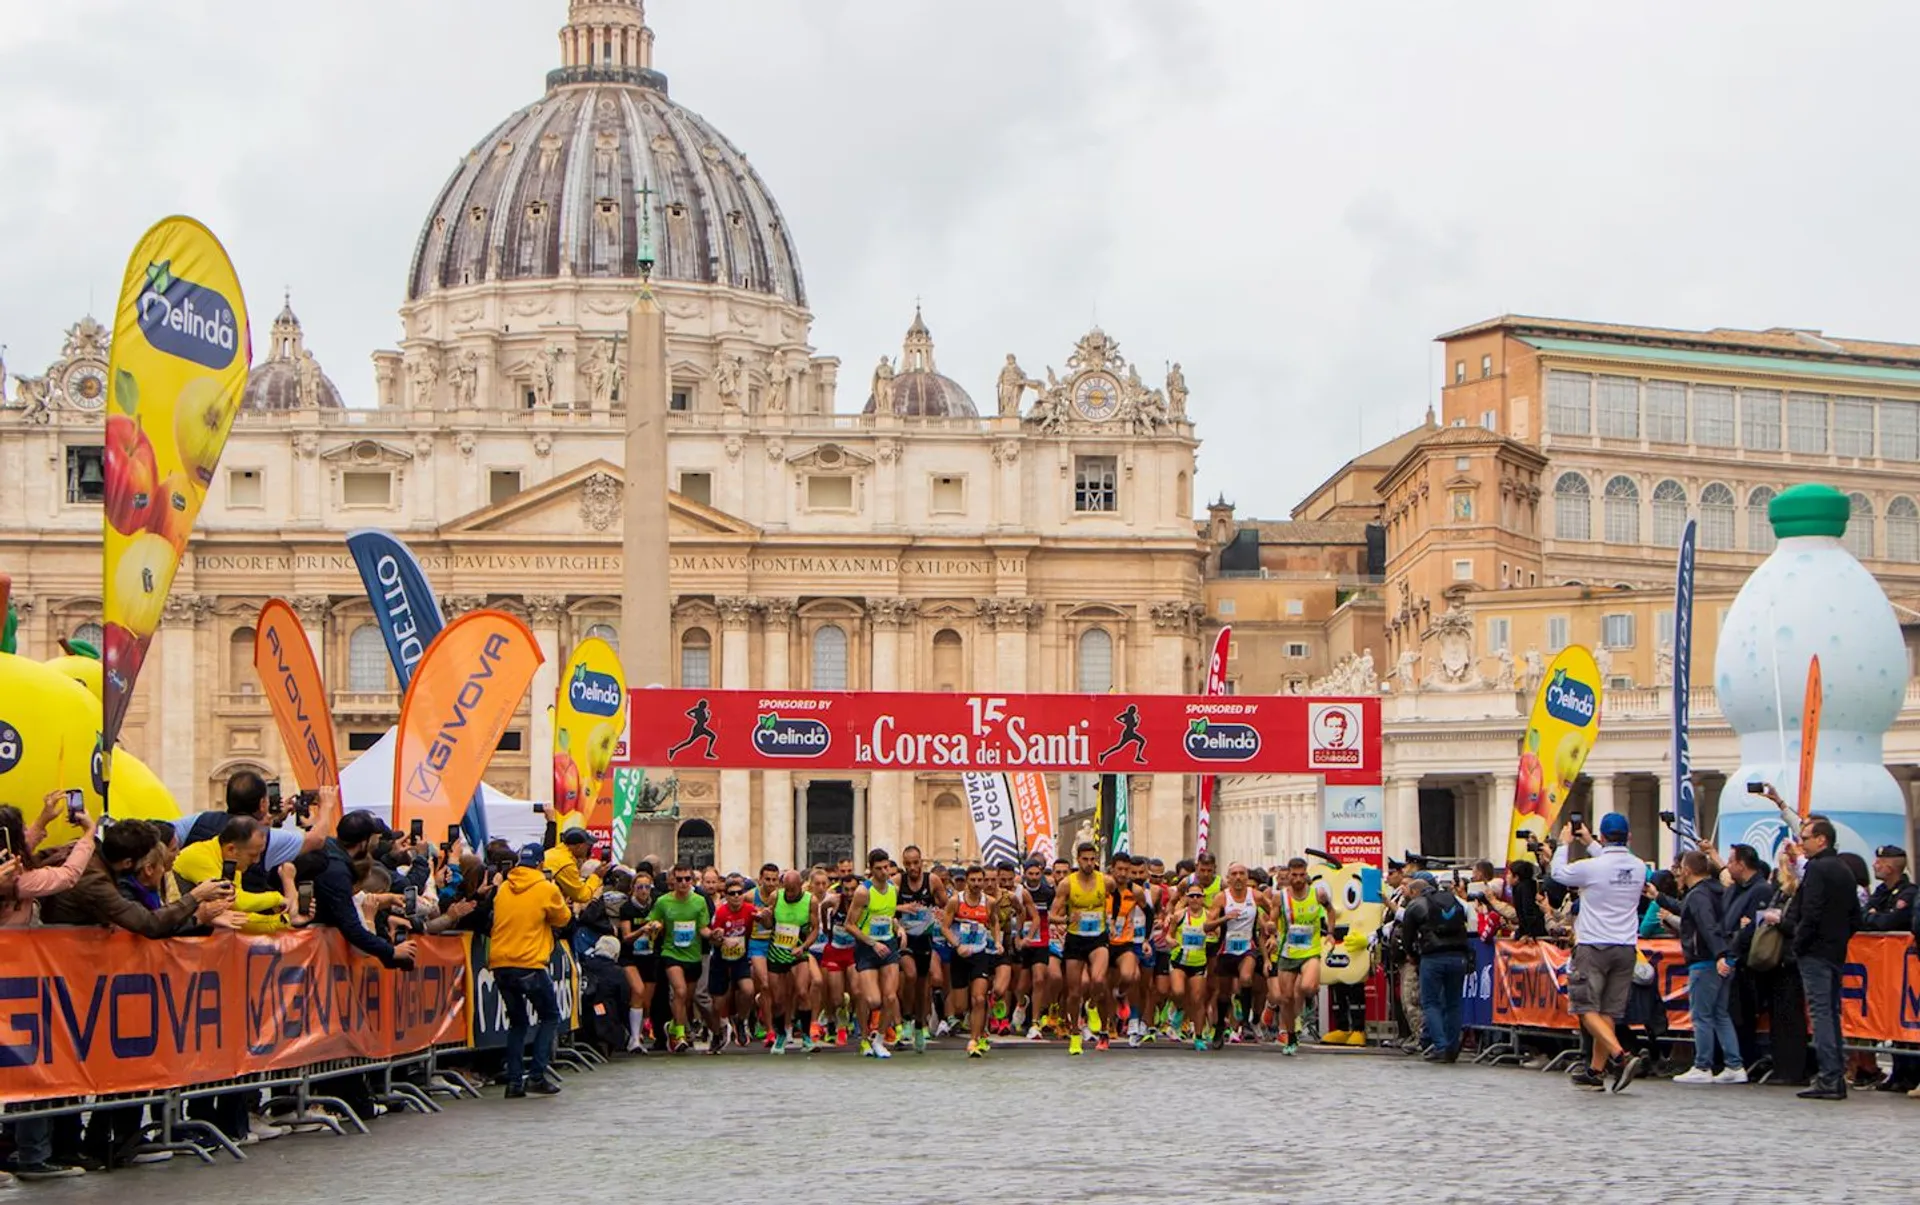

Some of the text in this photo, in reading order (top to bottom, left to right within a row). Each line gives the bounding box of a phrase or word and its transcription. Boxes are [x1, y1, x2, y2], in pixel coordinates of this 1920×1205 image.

[141, 290, 234, 350] Melinda
[195, 556, 292, 570] HONOREM
[751, 558, 798, 572] PONT
[948, 560, 993, 574] PONT
[426, 632, 510, 771] GIVOVA
[571, 680, 619, 706] Melinda
[1547, 684, 1594, 718] Melinda
[758, 699, 832, 710] SPONSORED BY
[1185, 704, 1258, 714] SPONSORED BY
[966, 697, 1007, 736] 15
[757, 726, 825, 745] Melinda
[855, 715, 1090, 765] la Corsa dei Santi
[1190, 730, 1255, 749] Melinda
[1330, 836, 1380, 845] ACCORCIA
[1341, 846, 1381, 854] DISTANZE
[0, 970, 221, 1068] GIVOVA
